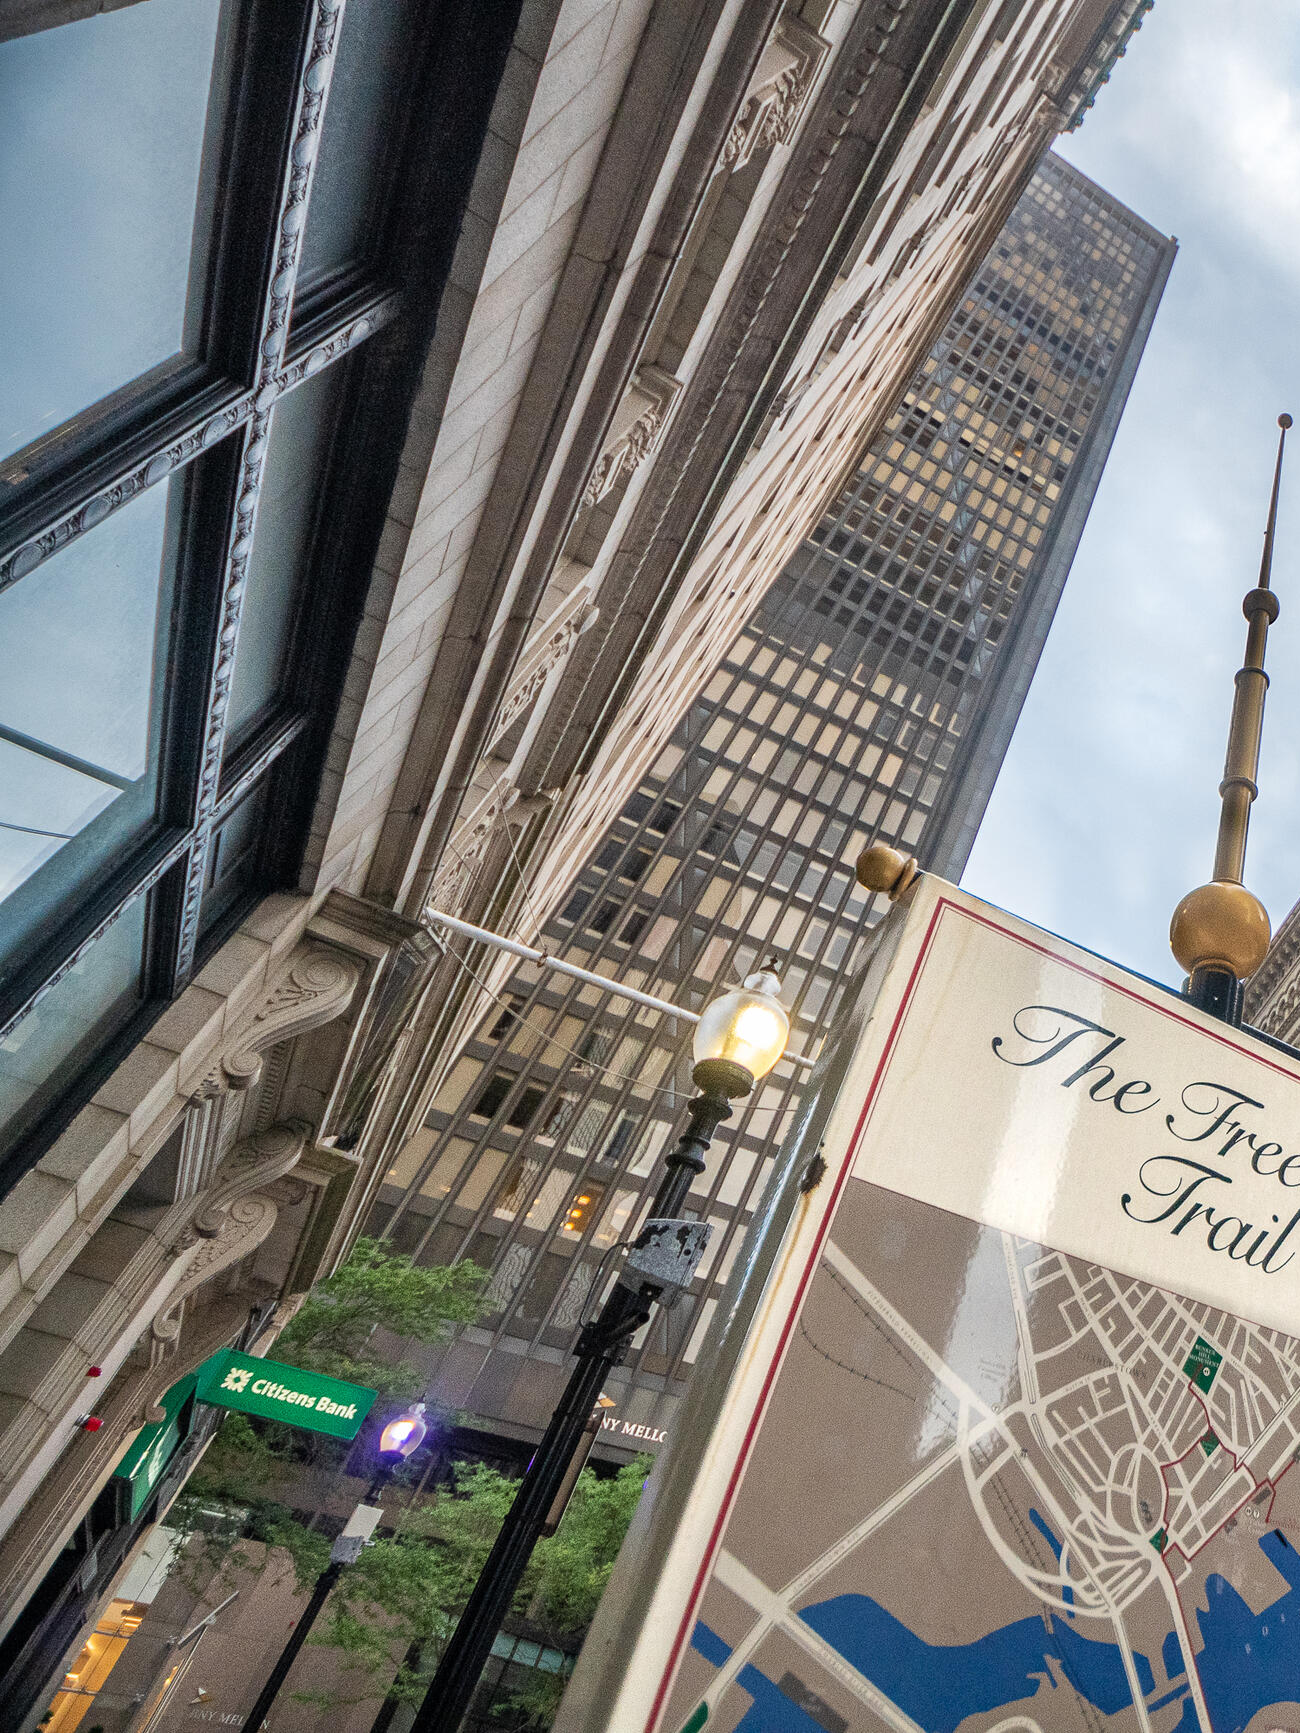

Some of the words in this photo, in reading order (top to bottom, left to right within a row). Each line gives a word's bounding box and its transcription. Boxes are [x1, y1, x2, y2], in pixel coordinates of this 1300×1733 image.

[991, 1005, 1161, 1115] The
[251, 1379, 317, 1409] Citizens
[315, 1396, 358, 1420] Bank
[600, 1416, 621, 1431] NY
[621, 1422, 668, 1443] MELLO
[220, 1712, 271, 1730] MELN
